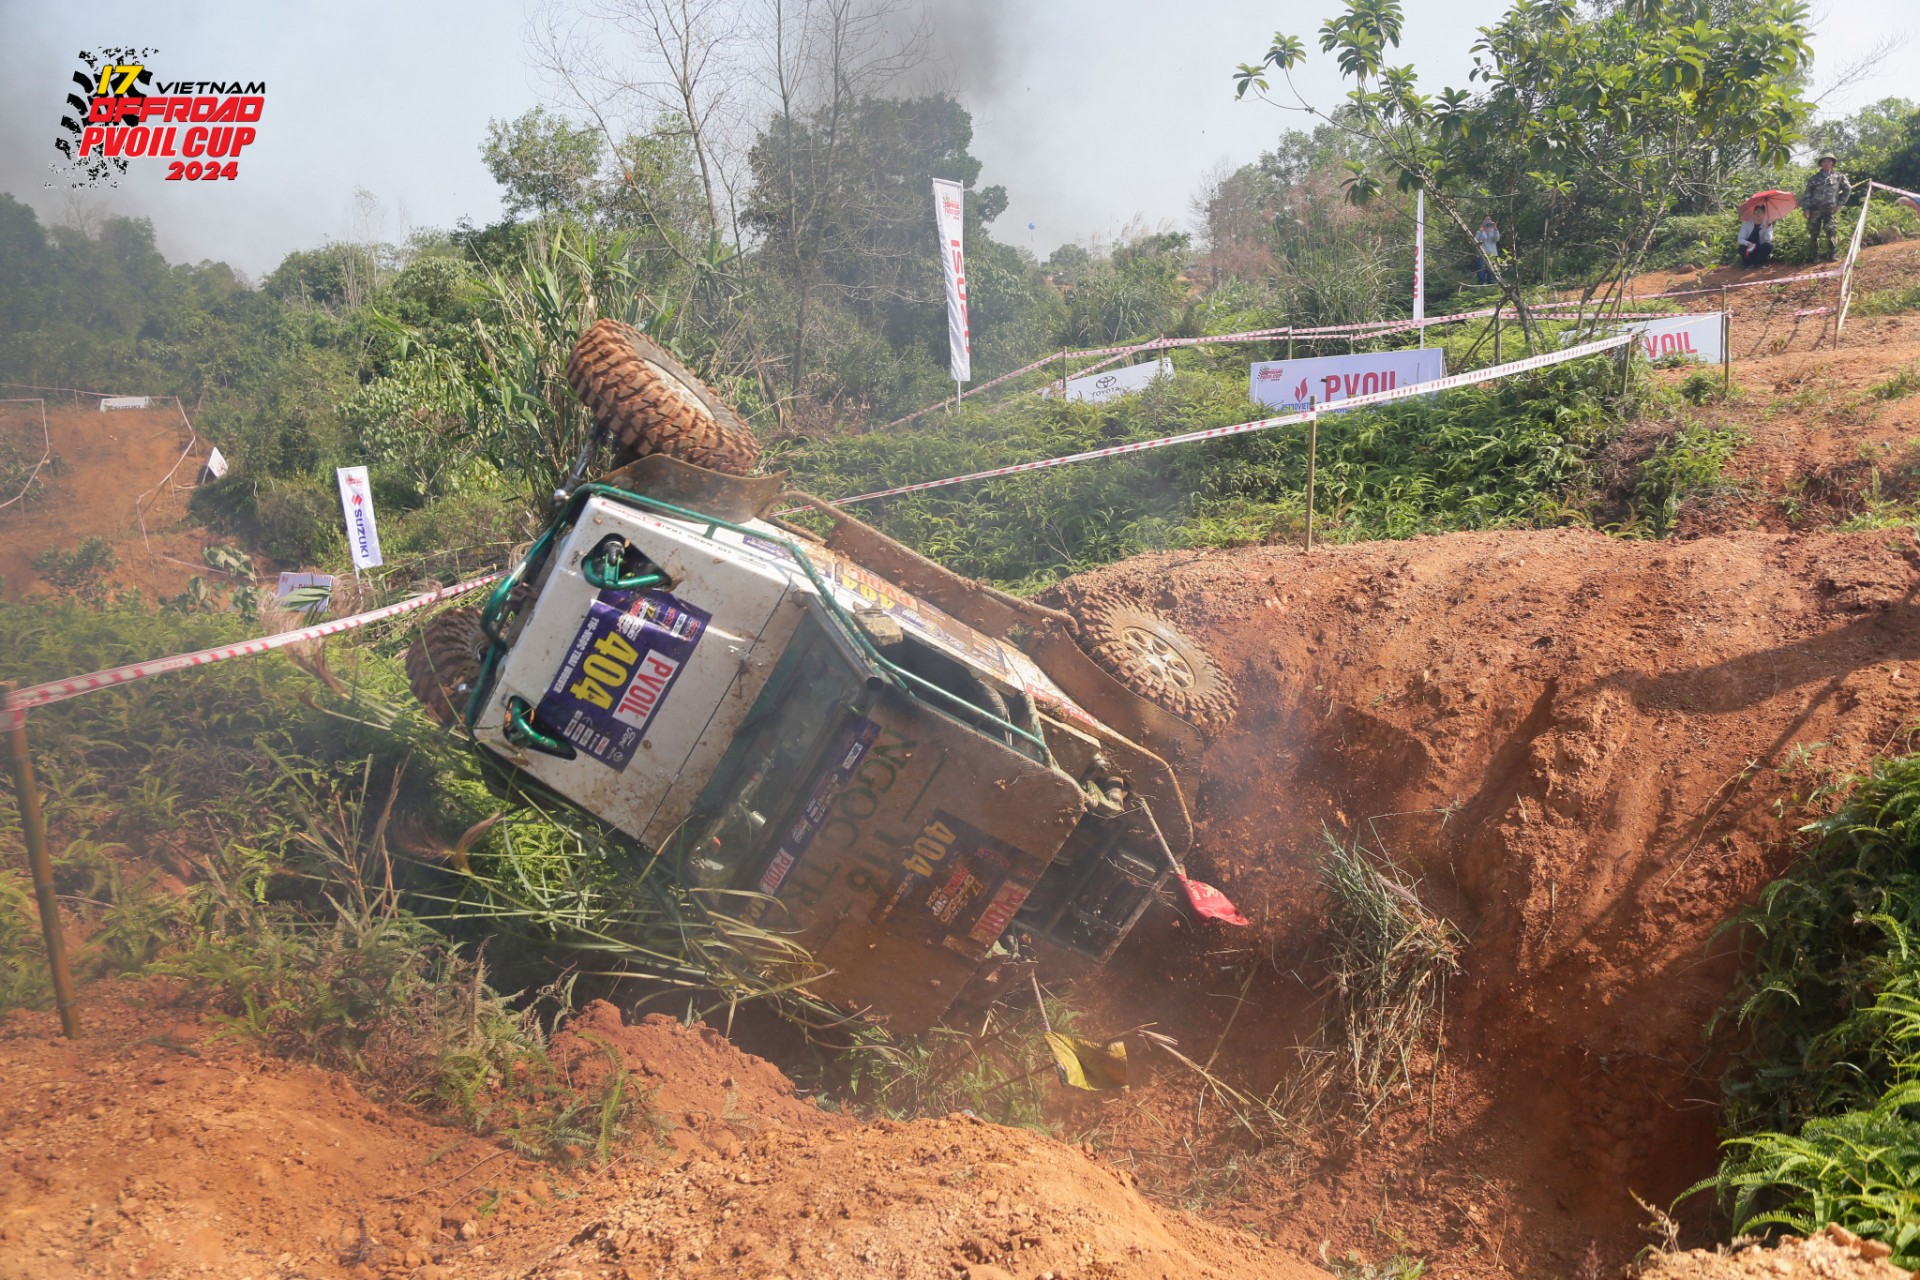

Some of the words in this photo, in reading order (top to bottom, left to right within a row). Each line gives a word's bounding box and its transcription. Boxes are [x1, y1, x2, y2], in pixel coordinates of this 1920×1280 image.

[1638, 331, 1697, 358] VOIL
[1092, 387, 1121, 397] TOYOTA
[354, 508, 369, 558] SUZUKI
[552, 664, 573, 693] WOLVER
[570, 631, 639, 710] 404
[617, 656, 674, 718] PVOIL
[617, 726, 637, 751] Ford
[901, 820, 957, 879] 404
[758, 851, 792, 893] PVOIL
[925, 885, 942, 907] 2024
